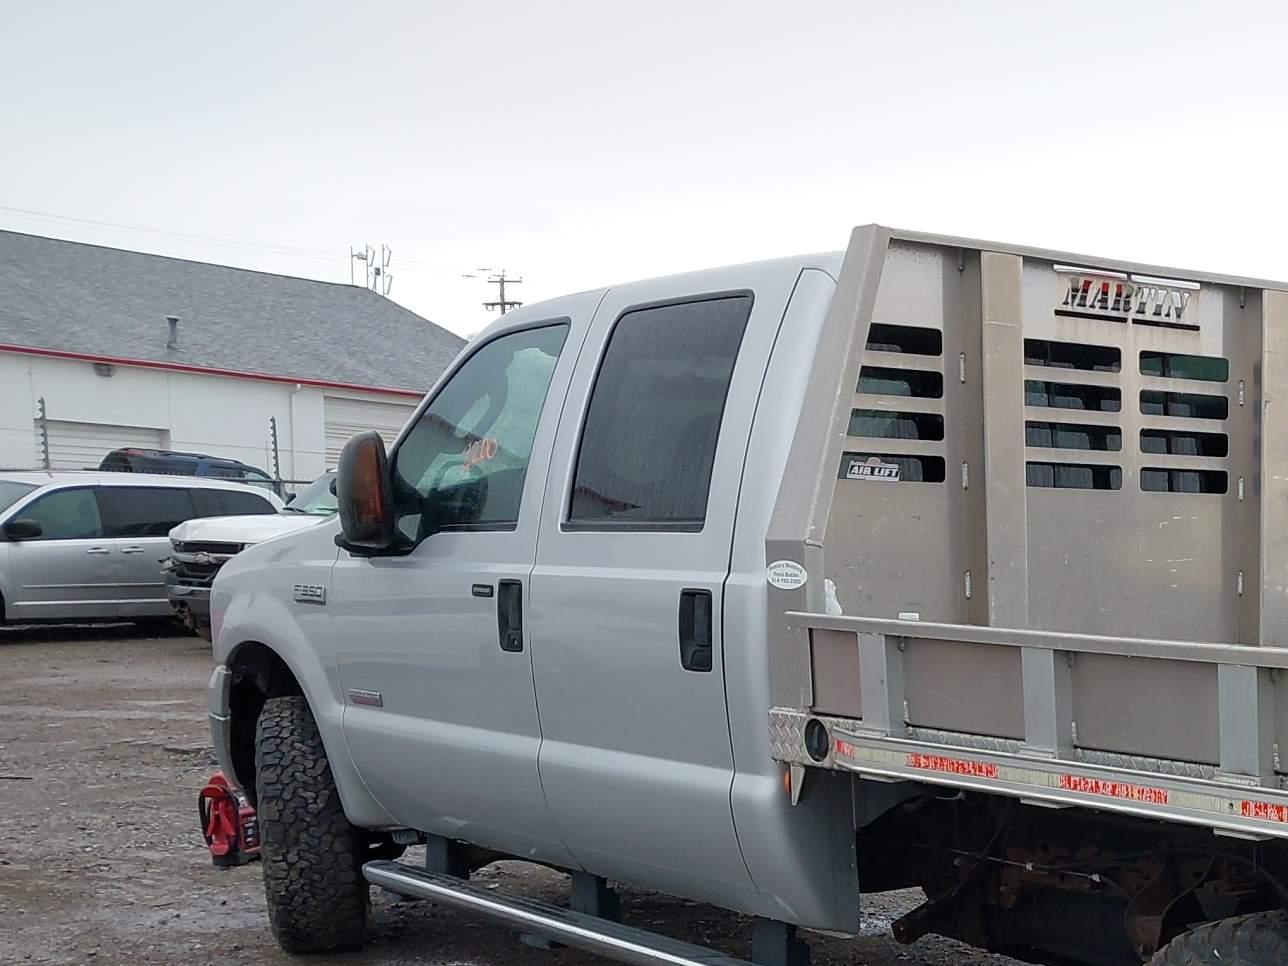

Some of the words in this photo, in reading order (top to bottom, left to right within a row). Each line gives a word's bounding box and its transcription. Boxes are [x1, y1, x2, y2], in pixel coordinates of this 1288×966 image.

[1062, 277, 1191, 319] MARTIN
[850, 465, 871, 475] AIR
[873, 467, 899, 477] LIFT
